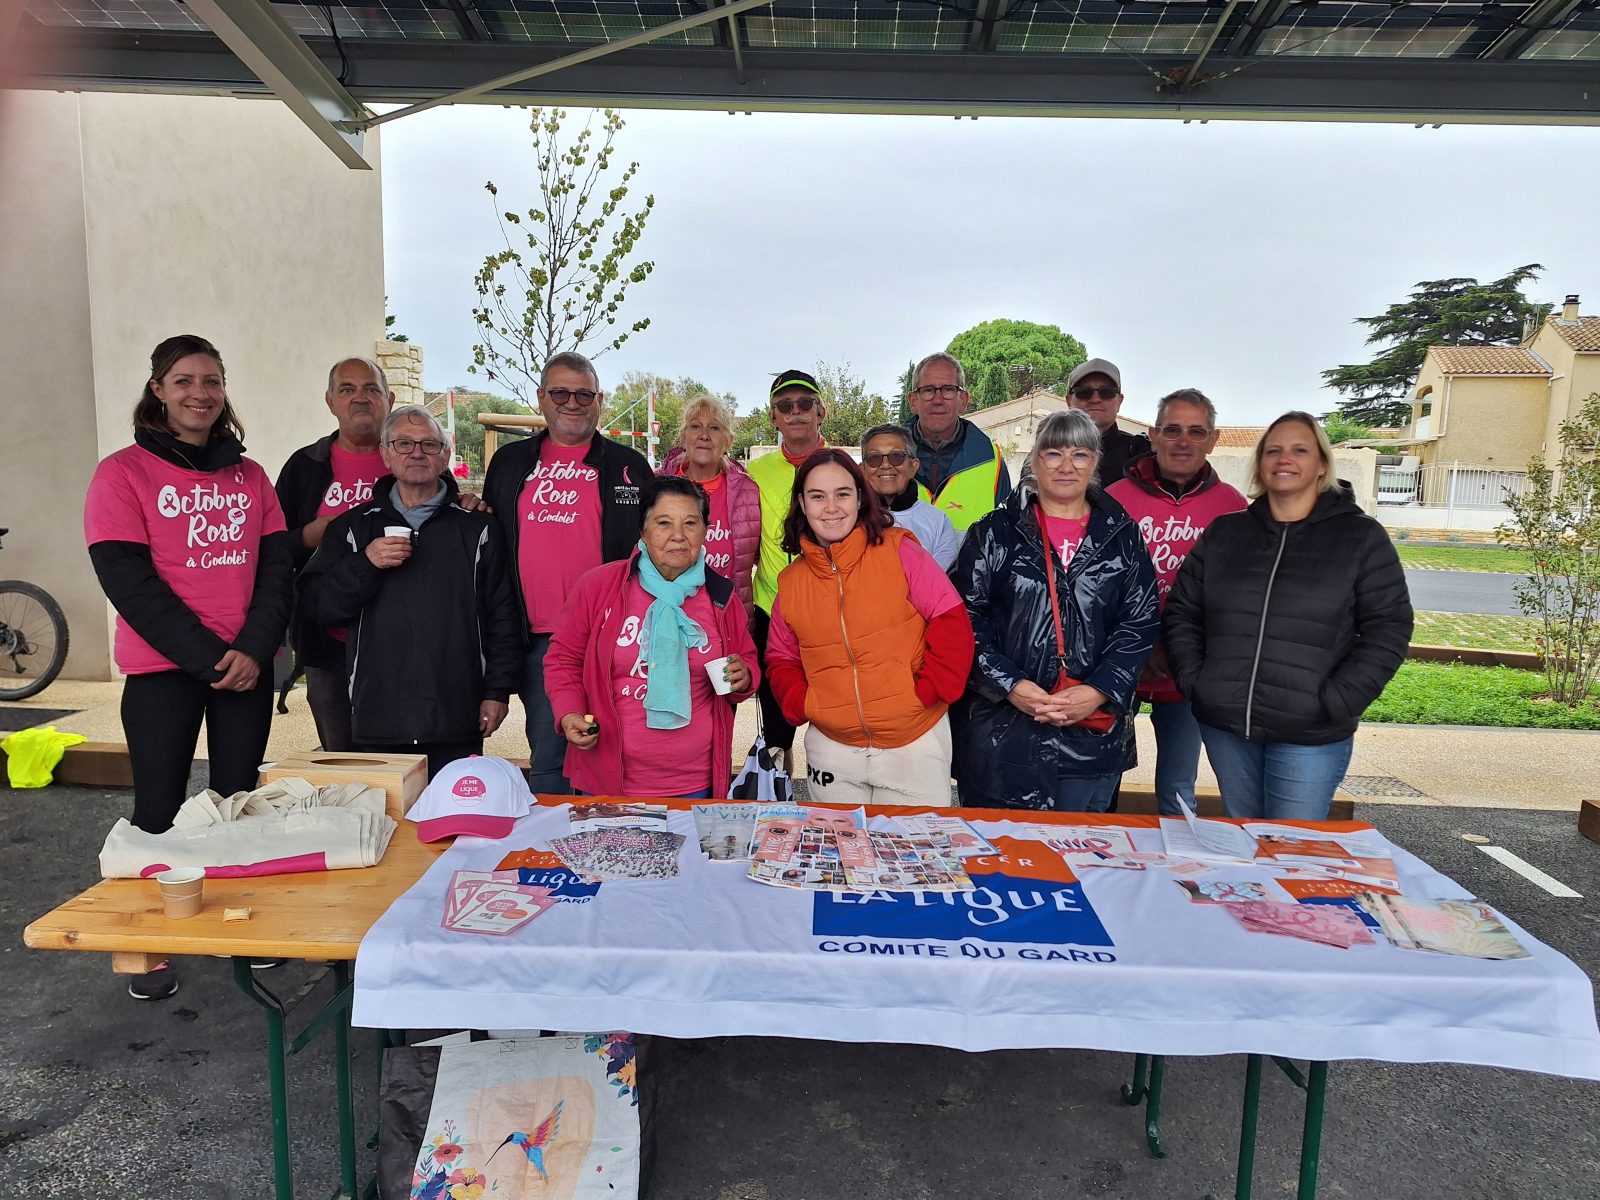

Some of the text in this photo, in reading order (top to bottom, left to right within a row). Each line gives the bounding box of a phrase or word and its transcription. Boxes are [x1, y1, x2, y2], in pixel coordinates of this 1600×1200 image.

[525, 460, 598, 481] Octobre
[157, 483, 252, 518] Octobre
[325, 477, 379, 507] Octo
[532, 480, 580, 505] Rose
[538, 509, 581, 524] Codolet
[186, 514, 245, 548] Rose
[1138, 515, 1205, 544] Octobr
[186, 549, 250, 569] à Codolet
[1152, 543, 1186, 574] Ro
[959, 854, 1034, 868] NCER
[818, 940, 1117, 963] COMITE DU GARD
